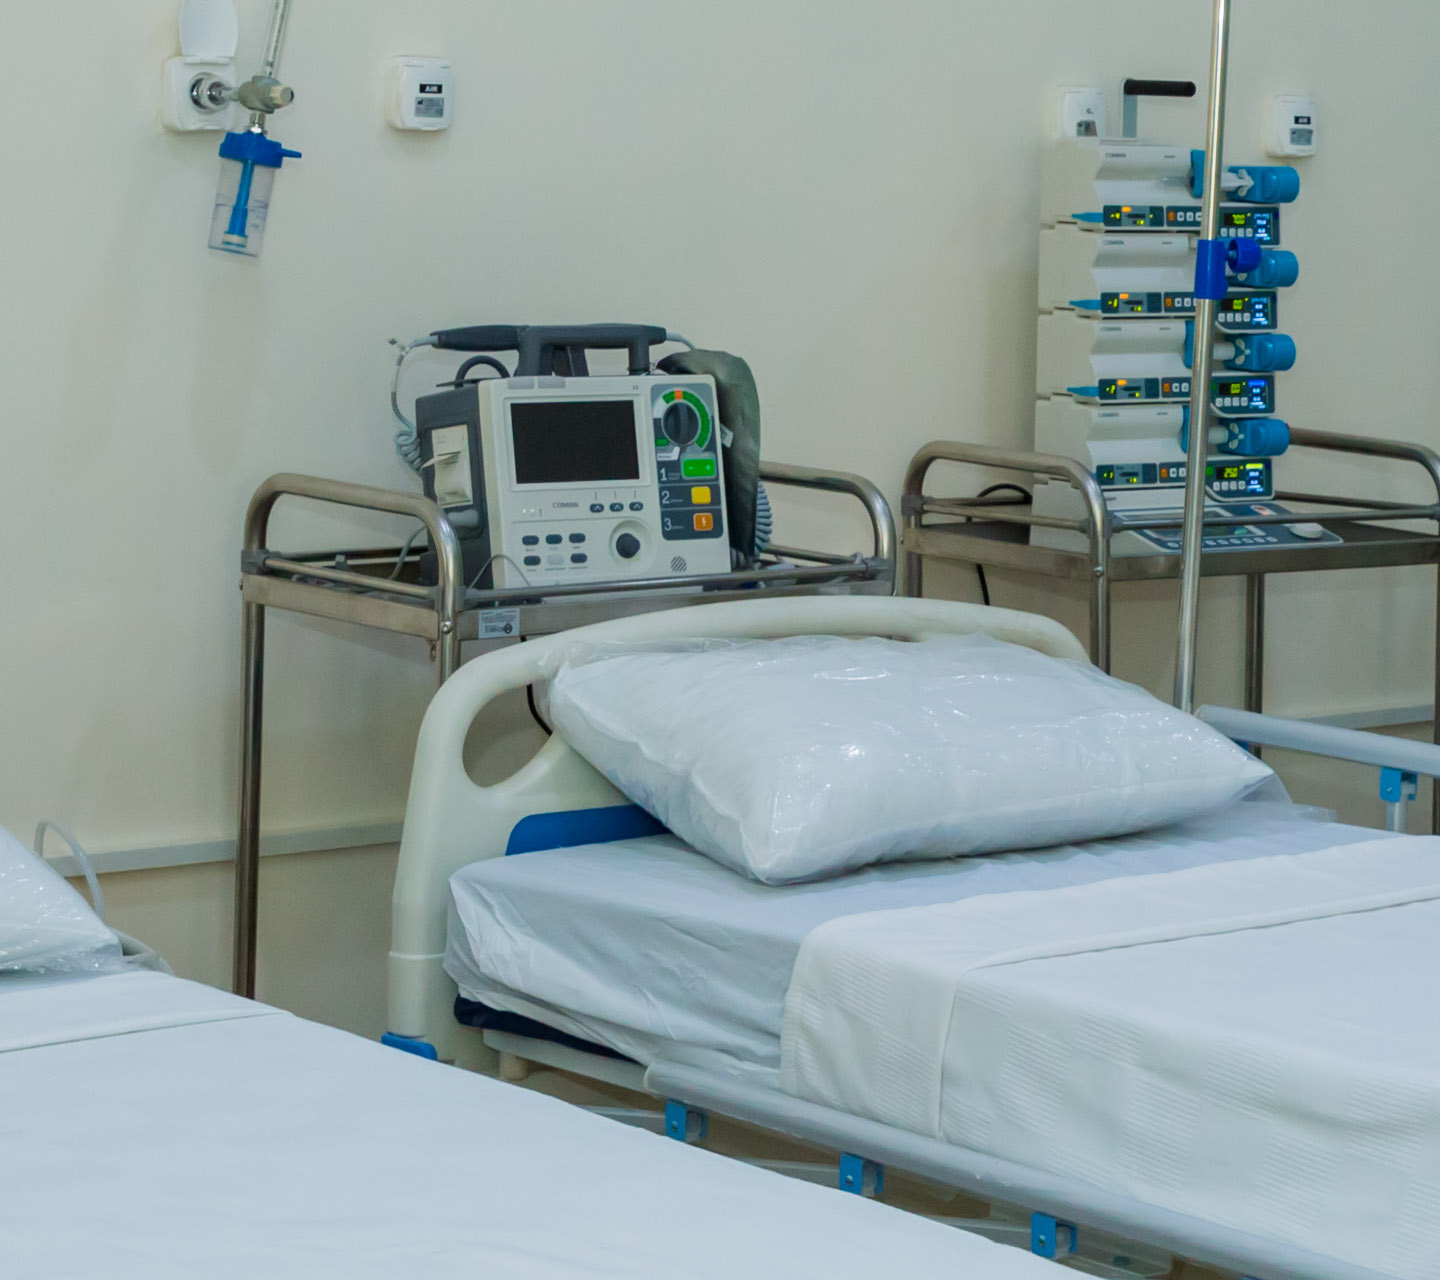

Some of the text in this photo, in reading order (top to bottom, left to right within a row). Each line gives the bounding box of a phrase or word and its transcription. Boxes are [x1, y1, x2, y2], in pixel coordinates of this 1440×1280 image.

[659, 467, 667, 481] 1
[661, 490, 670, 504] 2
[664, 517, 672, 531] 3
